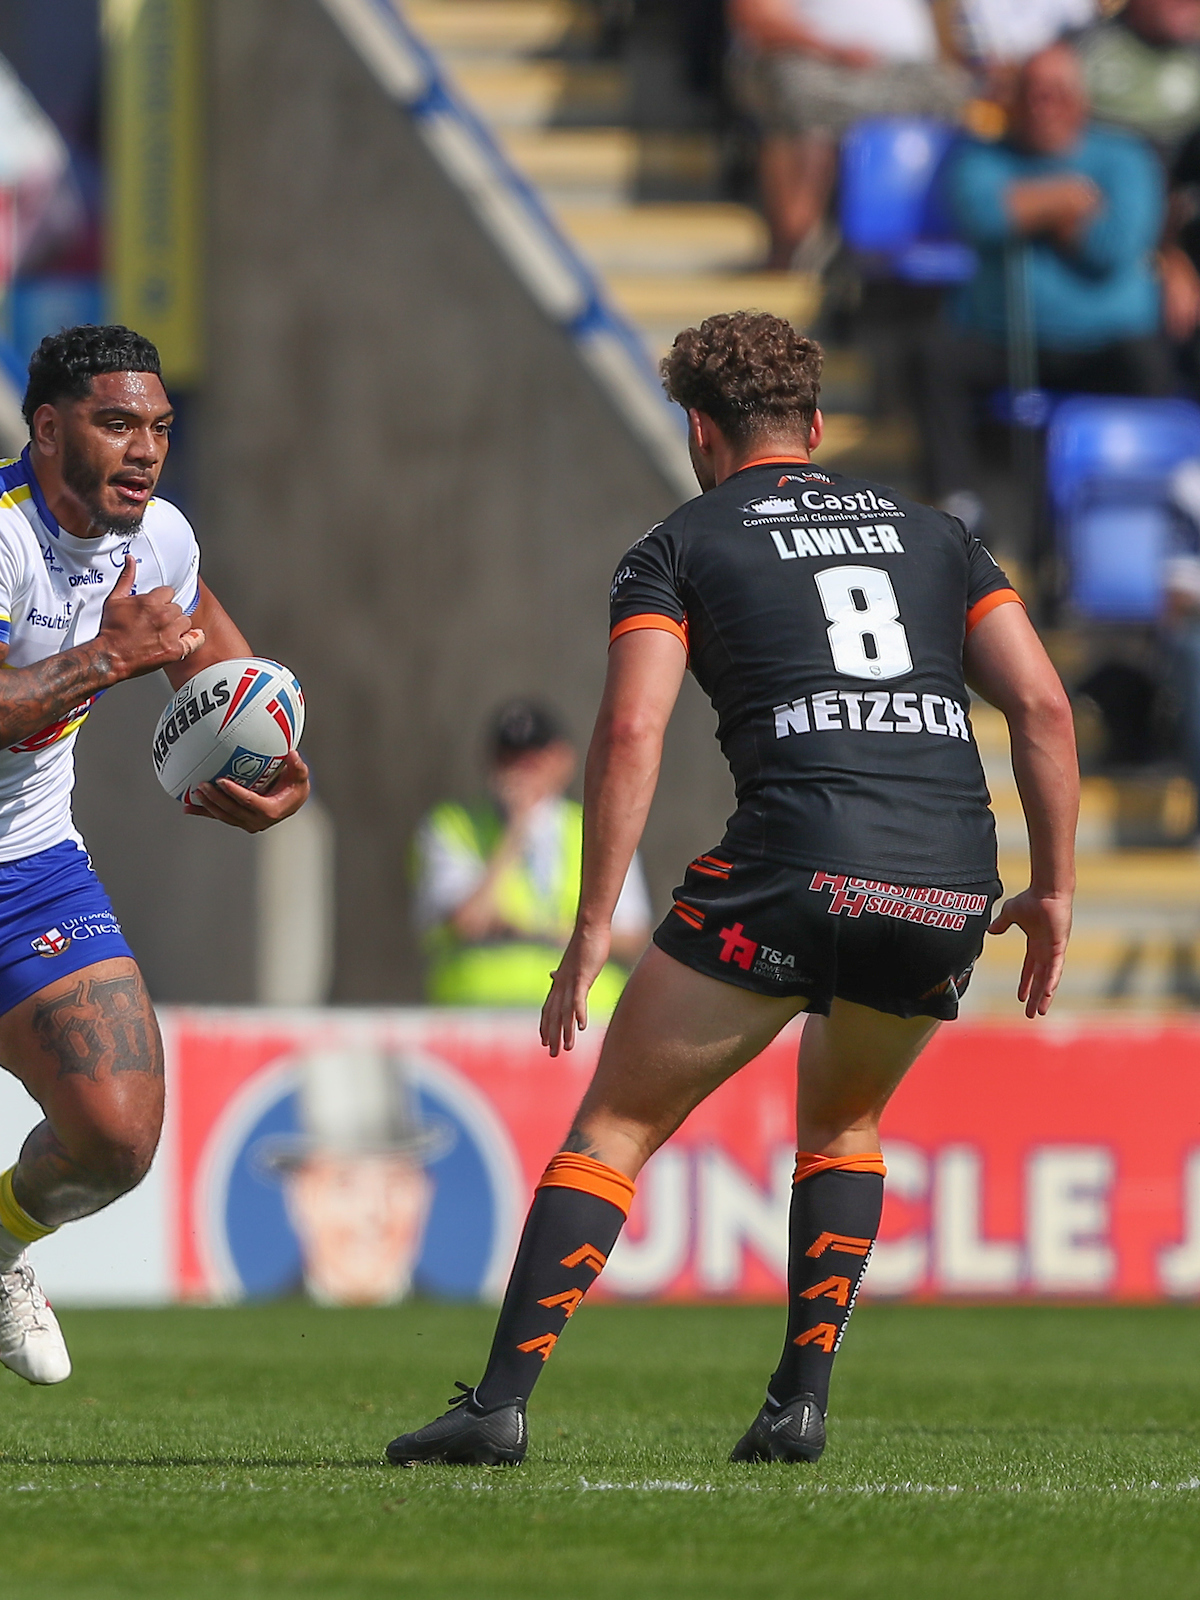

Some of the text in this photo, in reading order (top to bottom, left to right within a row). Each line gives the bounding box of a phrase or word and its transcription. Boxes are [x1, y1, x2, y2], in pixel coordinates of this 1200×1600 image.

[801, 490, 898, 512] Castle
[743, 511, 906, 528] Commercial Cleaning Services
[769, 524, 905, 559] LAWLER
[813, 565, 913, 680] 8
[152, 679, 230, 773] STEEDEN
[773, 689, 970, 742] NETZSCH
[848, 877, 988, 912] CONSTRUCTION
[865, 896, 967, 931] SURFACING
[760, 945, 795, 968] T&A
[606, 1143, 1114, 1294] UNCLE
